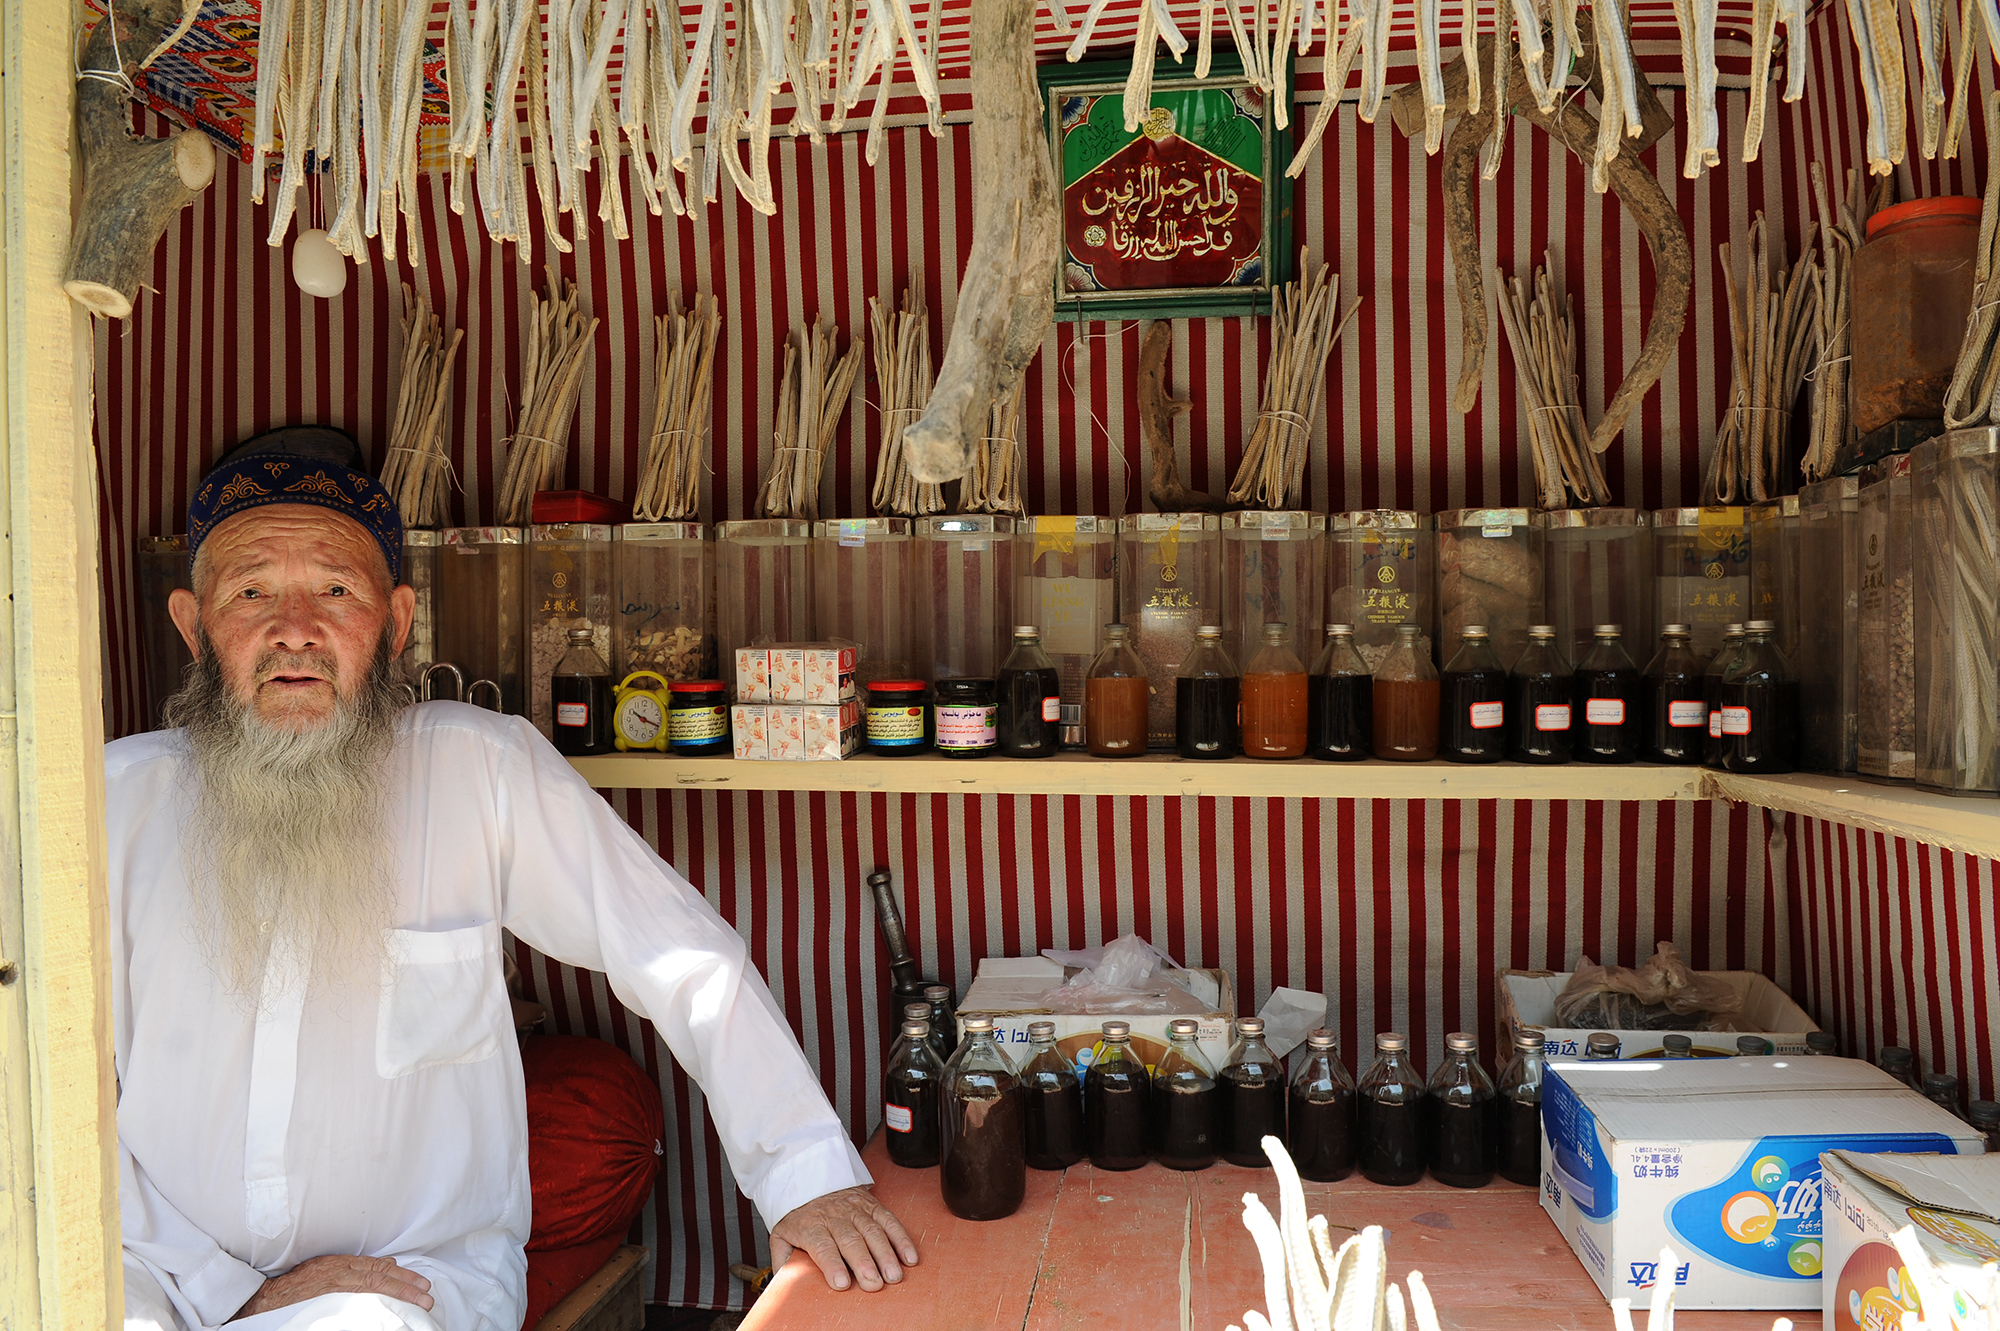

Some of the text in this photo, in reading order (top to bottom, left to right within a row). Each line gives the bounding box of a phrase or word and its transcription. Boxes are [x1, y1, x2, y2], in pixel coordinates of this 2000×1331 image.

[1052, 583, 1074, 594] WU
[539, 599, 579, 612] 五粮液
[1042, 597, 1084, 608] LIANG
[1145, 594, 1192, 608] 五粮液
[1362, 595, 1411, 609] 五粮液
[1688, 593, 1741, 607] 五粮液
[1054, 611, 1073, 622] YE
[1543, 1039, 1579, 1056] 南达
[1633, 1165, 1679, 1179] 纯牛奶
[1544, 1172, 1562, 1209] 南达
